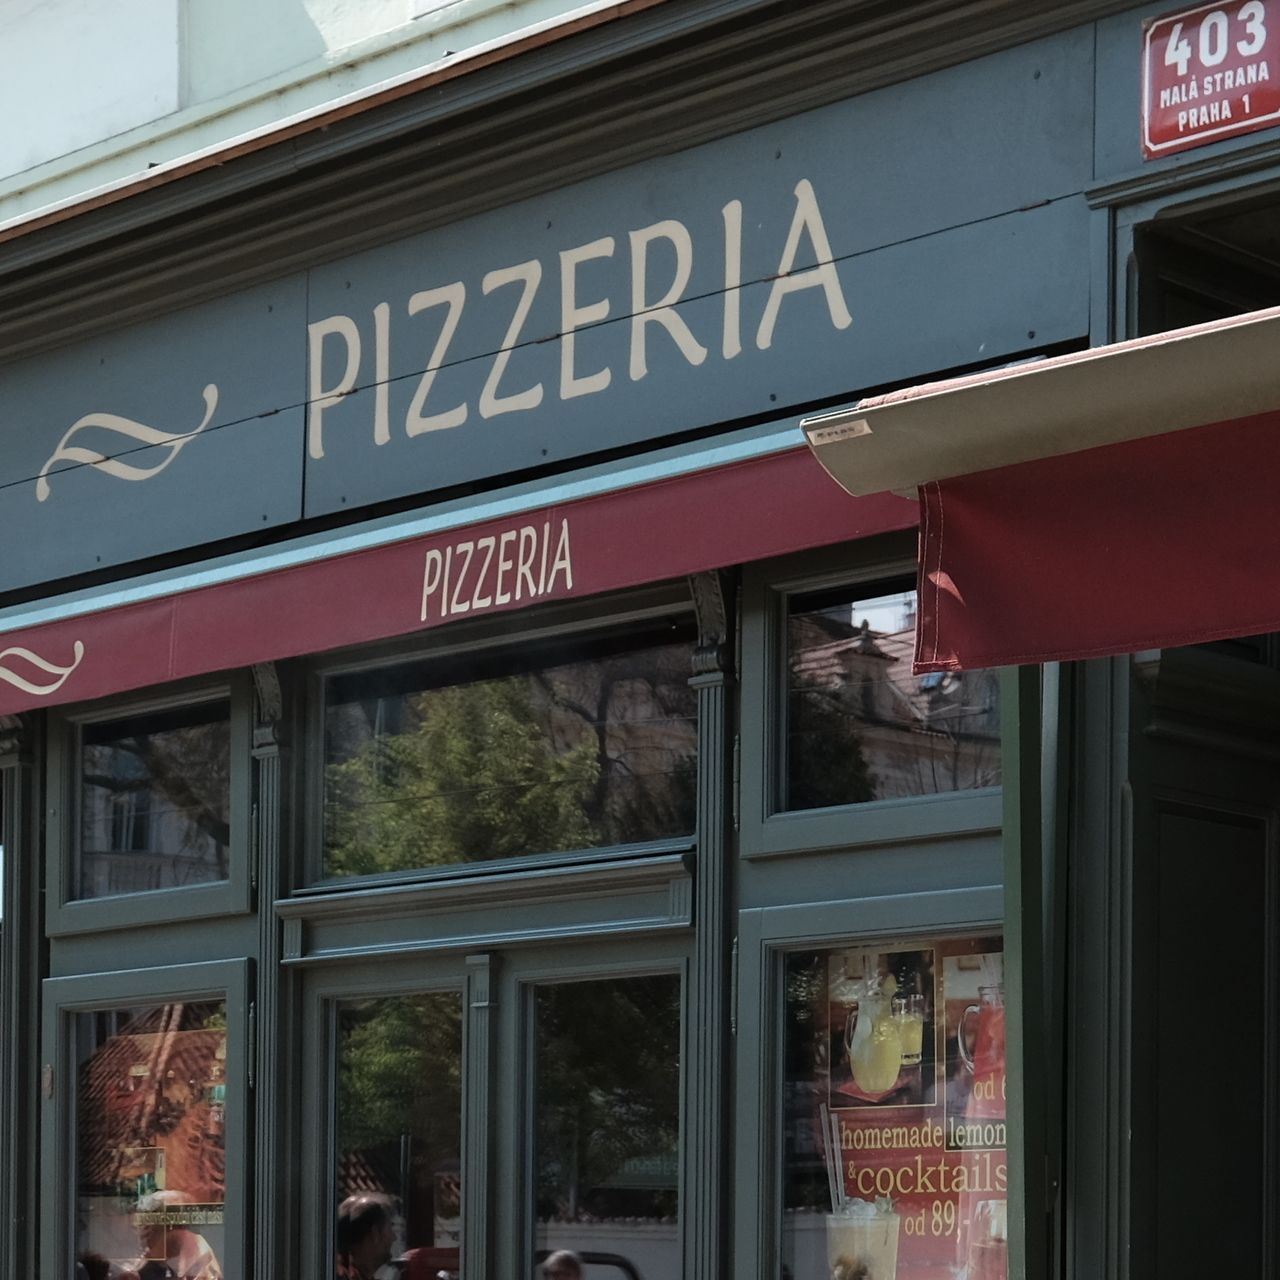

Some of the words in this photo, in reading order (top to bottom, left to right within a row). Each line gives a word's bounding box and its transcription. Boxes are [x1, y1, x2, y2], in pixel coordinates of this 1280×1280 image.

[1164, 0, 1267, 77] 403
[1160, 75, 1199, 109] MALÁ
[1203, 61, 1270, 96] STRANA
[1178, 99, 1233, 132] PRAHA
[1241, 94, 1251, 114] 1
[306, 178, 853, 460] PIZZERIA
[420, 518, 574, 622] PIZZERIA
[841, 1118, 944, 1150] homemade
[905, 1208, 926, 1236] od
